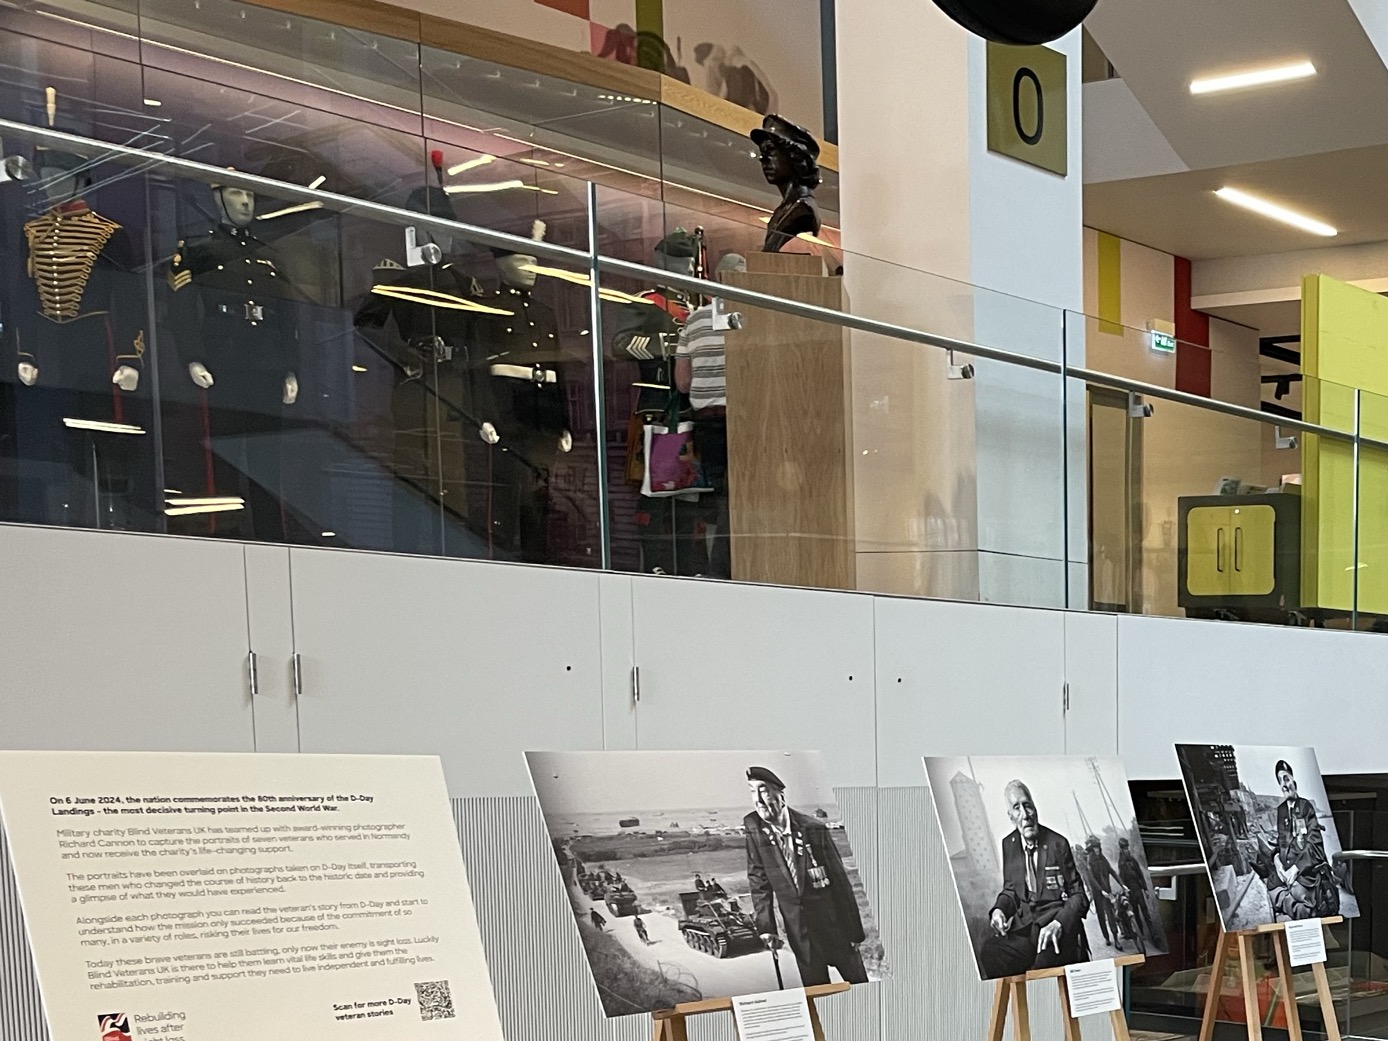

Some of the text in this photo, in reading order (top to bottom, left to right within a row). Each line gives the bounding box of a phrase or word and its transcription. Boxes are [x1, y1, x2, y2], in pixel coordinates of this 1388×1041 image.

[49, 796, 64, 804] On
[65, 796, 71, 804] 6
[74, 796, 95, 804] June
[125, 795, 141, 803] the
[142, 795, 171, 803] nation
[278, 794, 324, 803] anniversary
[349, 794, 373, 803] D-Day
[51, 807, 95, 816] Landings
[102, 806, 118, 814] the
[145, 805, 182, 813] decisive
[183, 805, 216, 815] turning
[216, 805, 239, 814] point
[264, 804, 296, 812] Second
[92, 828, 125, 837] charity
[126, 826, 151, 835] Blind
[192, 826, 206, 834] UK
[206, 825, 223, 833] has
[224, 825, 259, 833] teamed
[272, 824, 291, 832] with
[352, 823, 405, 831] photographer
[58, 838, 96, 848] Richard
[96, 839, 135, 847] Cannon
[135, 838, 146, 846] to
[147, 838, 184, 846] capture
[184, 837, 201, 845] the
[201, 835, 240, 845] portraits
[240, 835, 250, 843] of
[315, 833, 333, 841] who
[333, 832, 362, 841] served
[370, 832, 410, 840] Normandy
[66, 872, 84, 880] The
[86, 870, 128, 881] portraits
[128, 870, 152, 878] have
[152, 869, 178, 877] been
[178, 867, 215, 876] overlaid
[228, 865, 284, 875] photographs
[284, 864, 309, 872] taken
[321, 862, 346, 871] D-Day
[368, 860, 417, 869] transporting
[67, 883, 96, 892] these
[121, 881, 142, 889] who
[143, 879, 185, 889] changed
[185, 878, 202, 886] the
[235, 876, 244, 884] of
[244, 876, 275, 884] history
[275, 874, 297, 882] back
[308, 873, 322, 881] the
[323, 872, 353, 880] historic
[354, 871, 372, 879] date
[373, 870, 389, 878] and
[389, 869, 424, 878] providing
[78, 894, 117, 904] glimpse
[118, 892, 128, 900] of
[129, 891, 154, 899] what
[155, 890, 176, 899] they
[177, 888, 206, 897] would
[205, 888, 228, 896] have
[76, 914, 123, 925] Alongside
[124, 912, 149, 922] each
[149, 910, 204, 921] photograph
[204, 910, 222, 919] you
[241, 906, 261, 914] read
[262, 906, 277, 914] the
[278, 903, 316, 913] veteran's
[316, 903, 338, 911] story
[338, 901, 359, 909] from
[359, 900, 384, 908] D-Day
[384, 899, 400, 907] and
[400, 898, 419, 906] start
[109, 936, 120, 944] in
[128, 934, 161, 943] variety
[162, 932, 172, 940] of
[199, 929, 229, 939] risking
[229, 927, 249, 936] their
[251, 927, 271, 935] lives
[271, 925, 284, 933] for
[332, 1003, 353, 1011] Scan
[387, 997, 411, 1005] D-Day
[133, 1010, 186, 1023] Rebuilding
[334, 1008, 393, 1020] veteran stories
[135, 1022, 183, 1035] lives after
